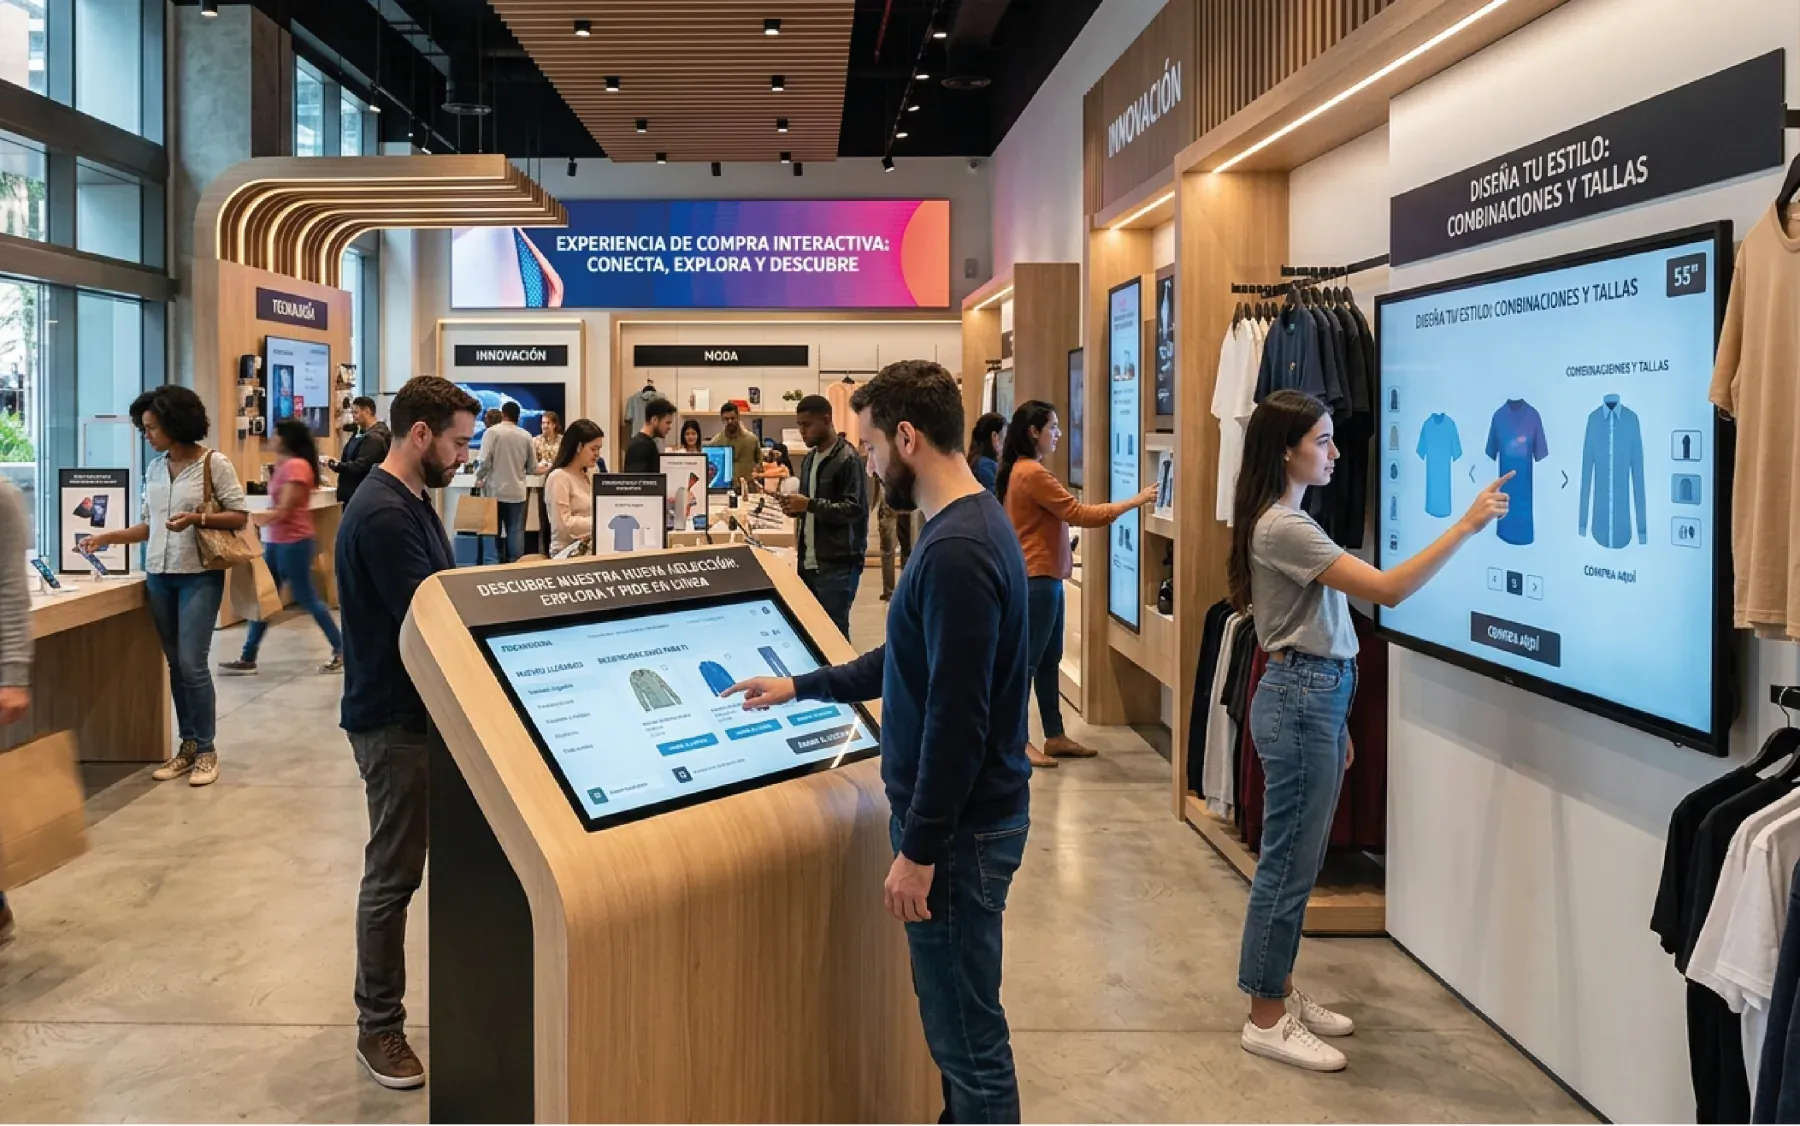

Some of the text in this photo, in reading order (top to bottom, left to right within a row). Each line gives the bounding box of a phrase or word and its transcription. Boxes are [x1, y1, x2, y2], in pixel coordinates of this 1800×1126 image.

[1470, 135, 1610, 202] DISEÑA TU ESTILO:
[1447, 155, 1649, 237] COMBINACIONES Y TALLAS
[556, 234, 890, 252] EXPERIENCIA DE COMPRA INTERACTIVA:
[586, 256, 860, 275] CONECTA, EXPLORA Y DESCUBRE
[1673, 263, 1699, 287] 55"
[1582, 285, 1590, 303] Y
[1592, 277, 1639, 302] TALLAS
[476, 347, 547, 361] INNOVACIÓN
[1639, 359, 1669, 373] TALLAS
[476, 576, 557, 597] DESCUBRE
[606, 585, 616, 598] Y
[618, 582, 652, 597] PIDE
